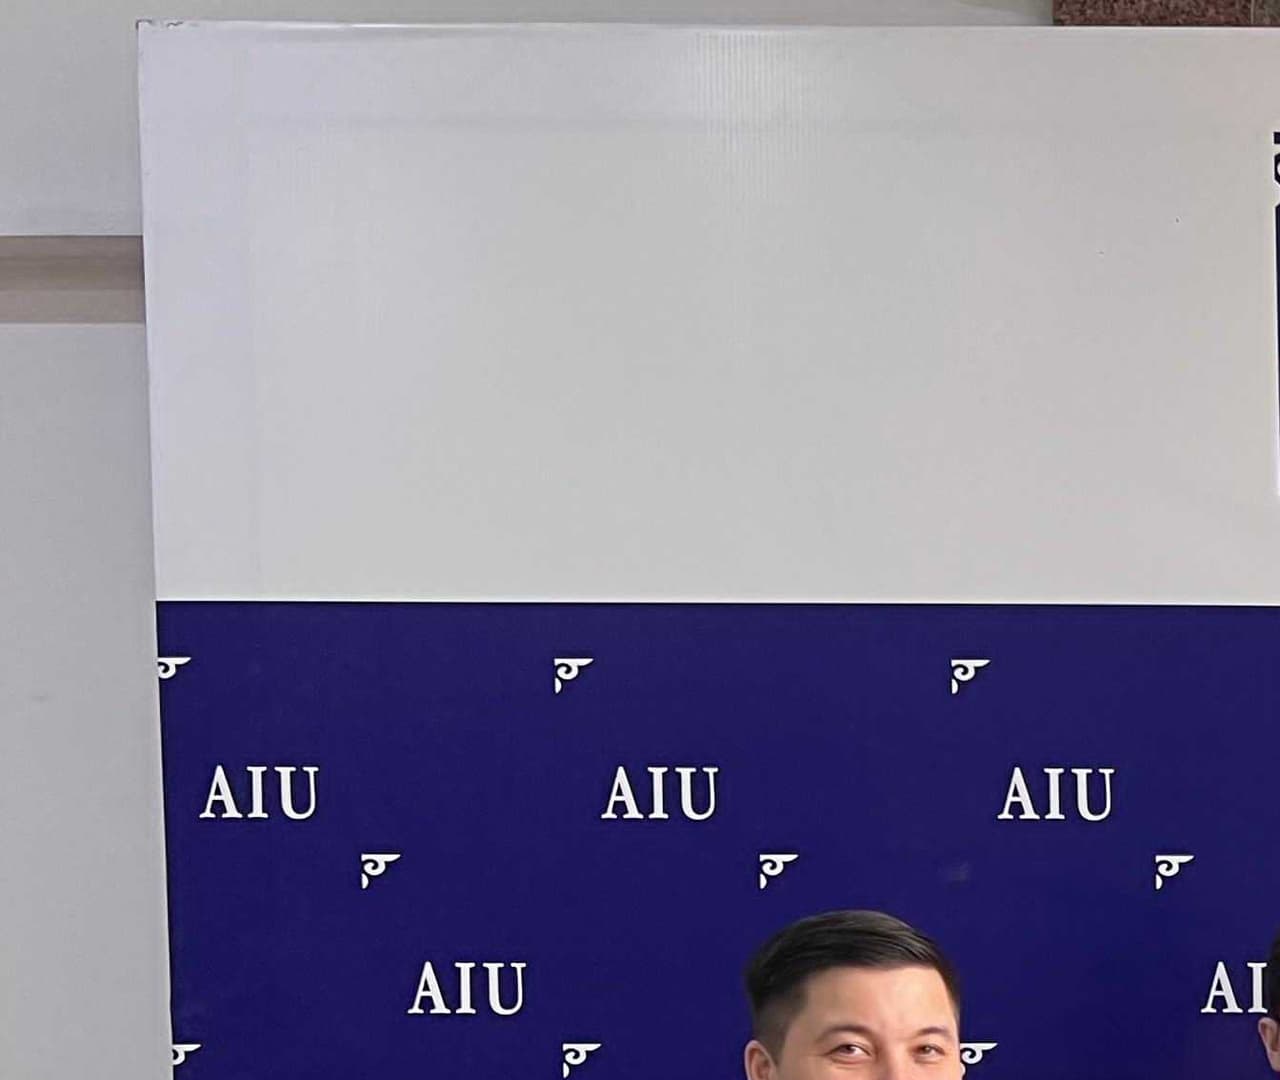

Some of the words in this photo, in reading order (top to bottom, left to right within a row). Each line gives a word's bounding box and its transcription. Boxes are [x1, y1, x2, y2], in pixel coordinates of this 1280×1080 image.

[199, 765, 319, 820] AIU
[601, 766, 719, 821] AIU
[997, 766, 1115, 821] AIU
[407, 961, 527, 1016] AIU
[1200, 961, 1269, 1014] AI
